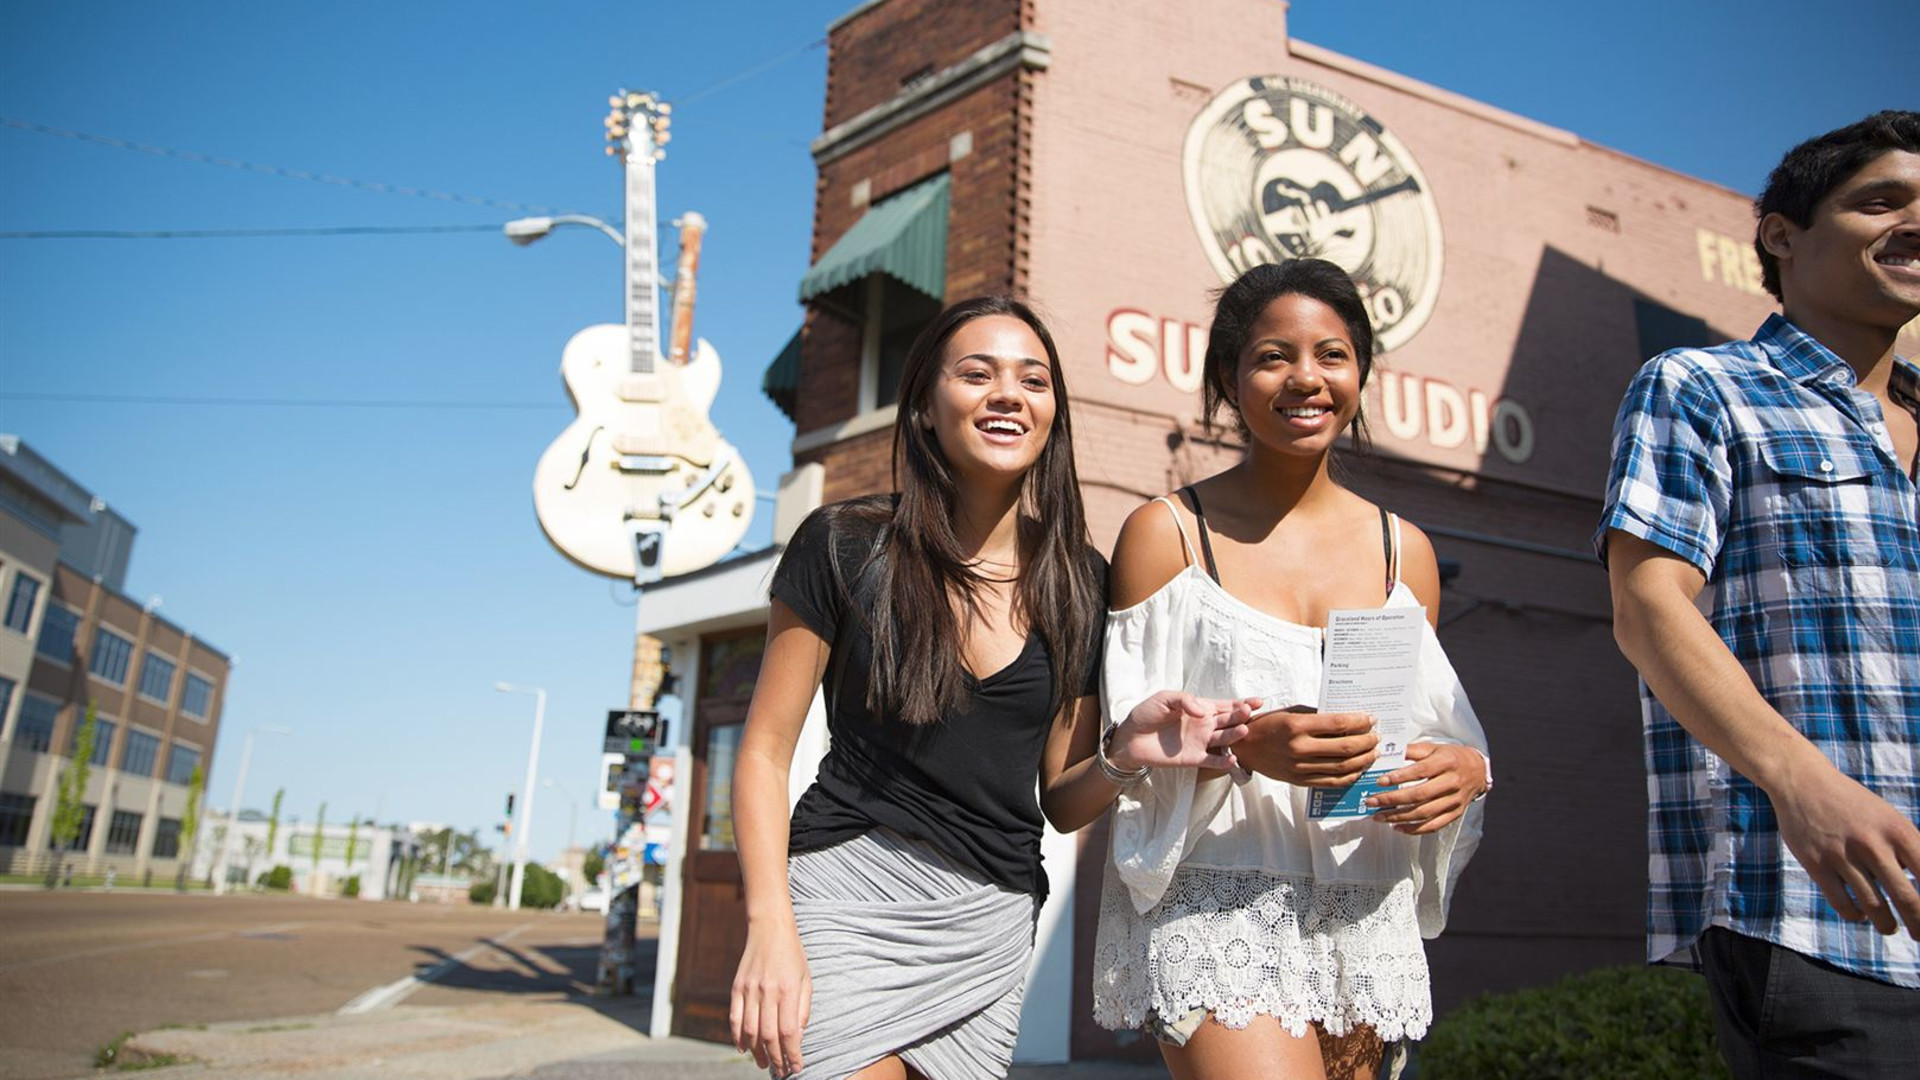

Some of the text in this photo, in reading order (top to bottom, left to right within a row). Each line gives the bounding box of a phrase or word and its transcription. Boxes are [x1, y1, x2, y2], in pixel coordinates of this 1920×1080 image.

[1243, 97, 1393, 186] SUN
[1696, 227, 1764, 297] FRE
[1106, 307, 1534, 464] SU UDIO
